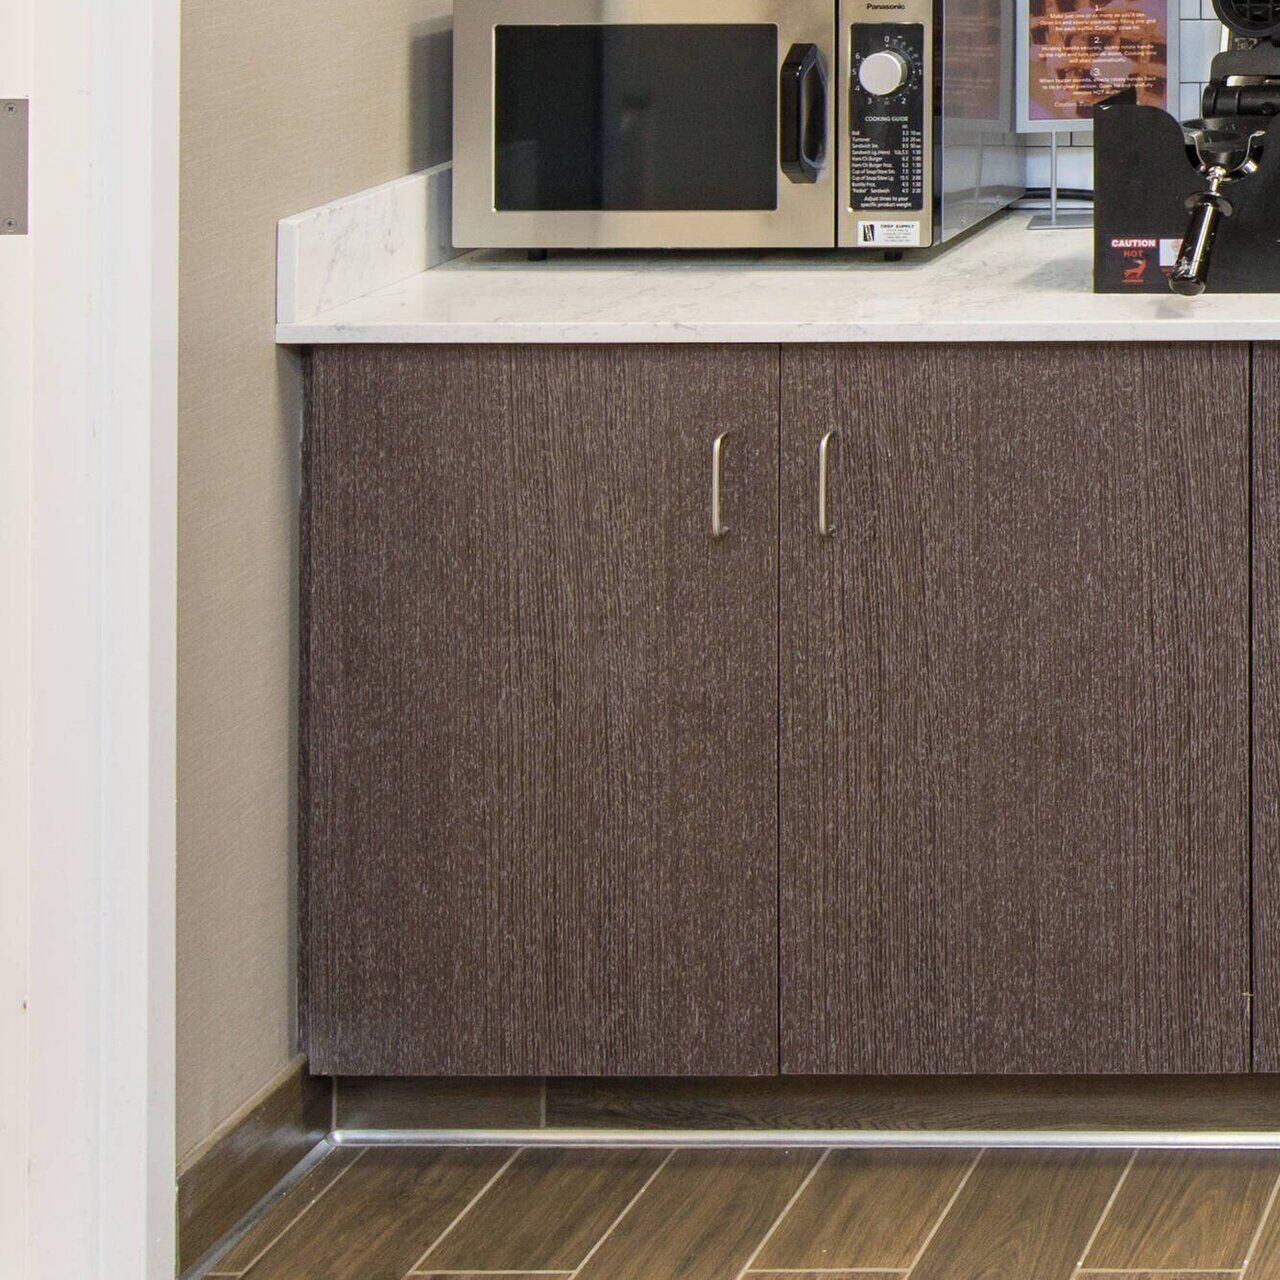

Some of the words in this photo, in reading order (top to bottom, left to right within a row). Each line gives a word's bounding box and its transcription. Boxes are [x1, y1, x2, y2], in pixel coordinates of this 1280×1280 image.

[901, 97, 907, 105] 2
[1111, 239, 1156, 248] CAUTION
[1122, 249, 1144, 257] HOT
